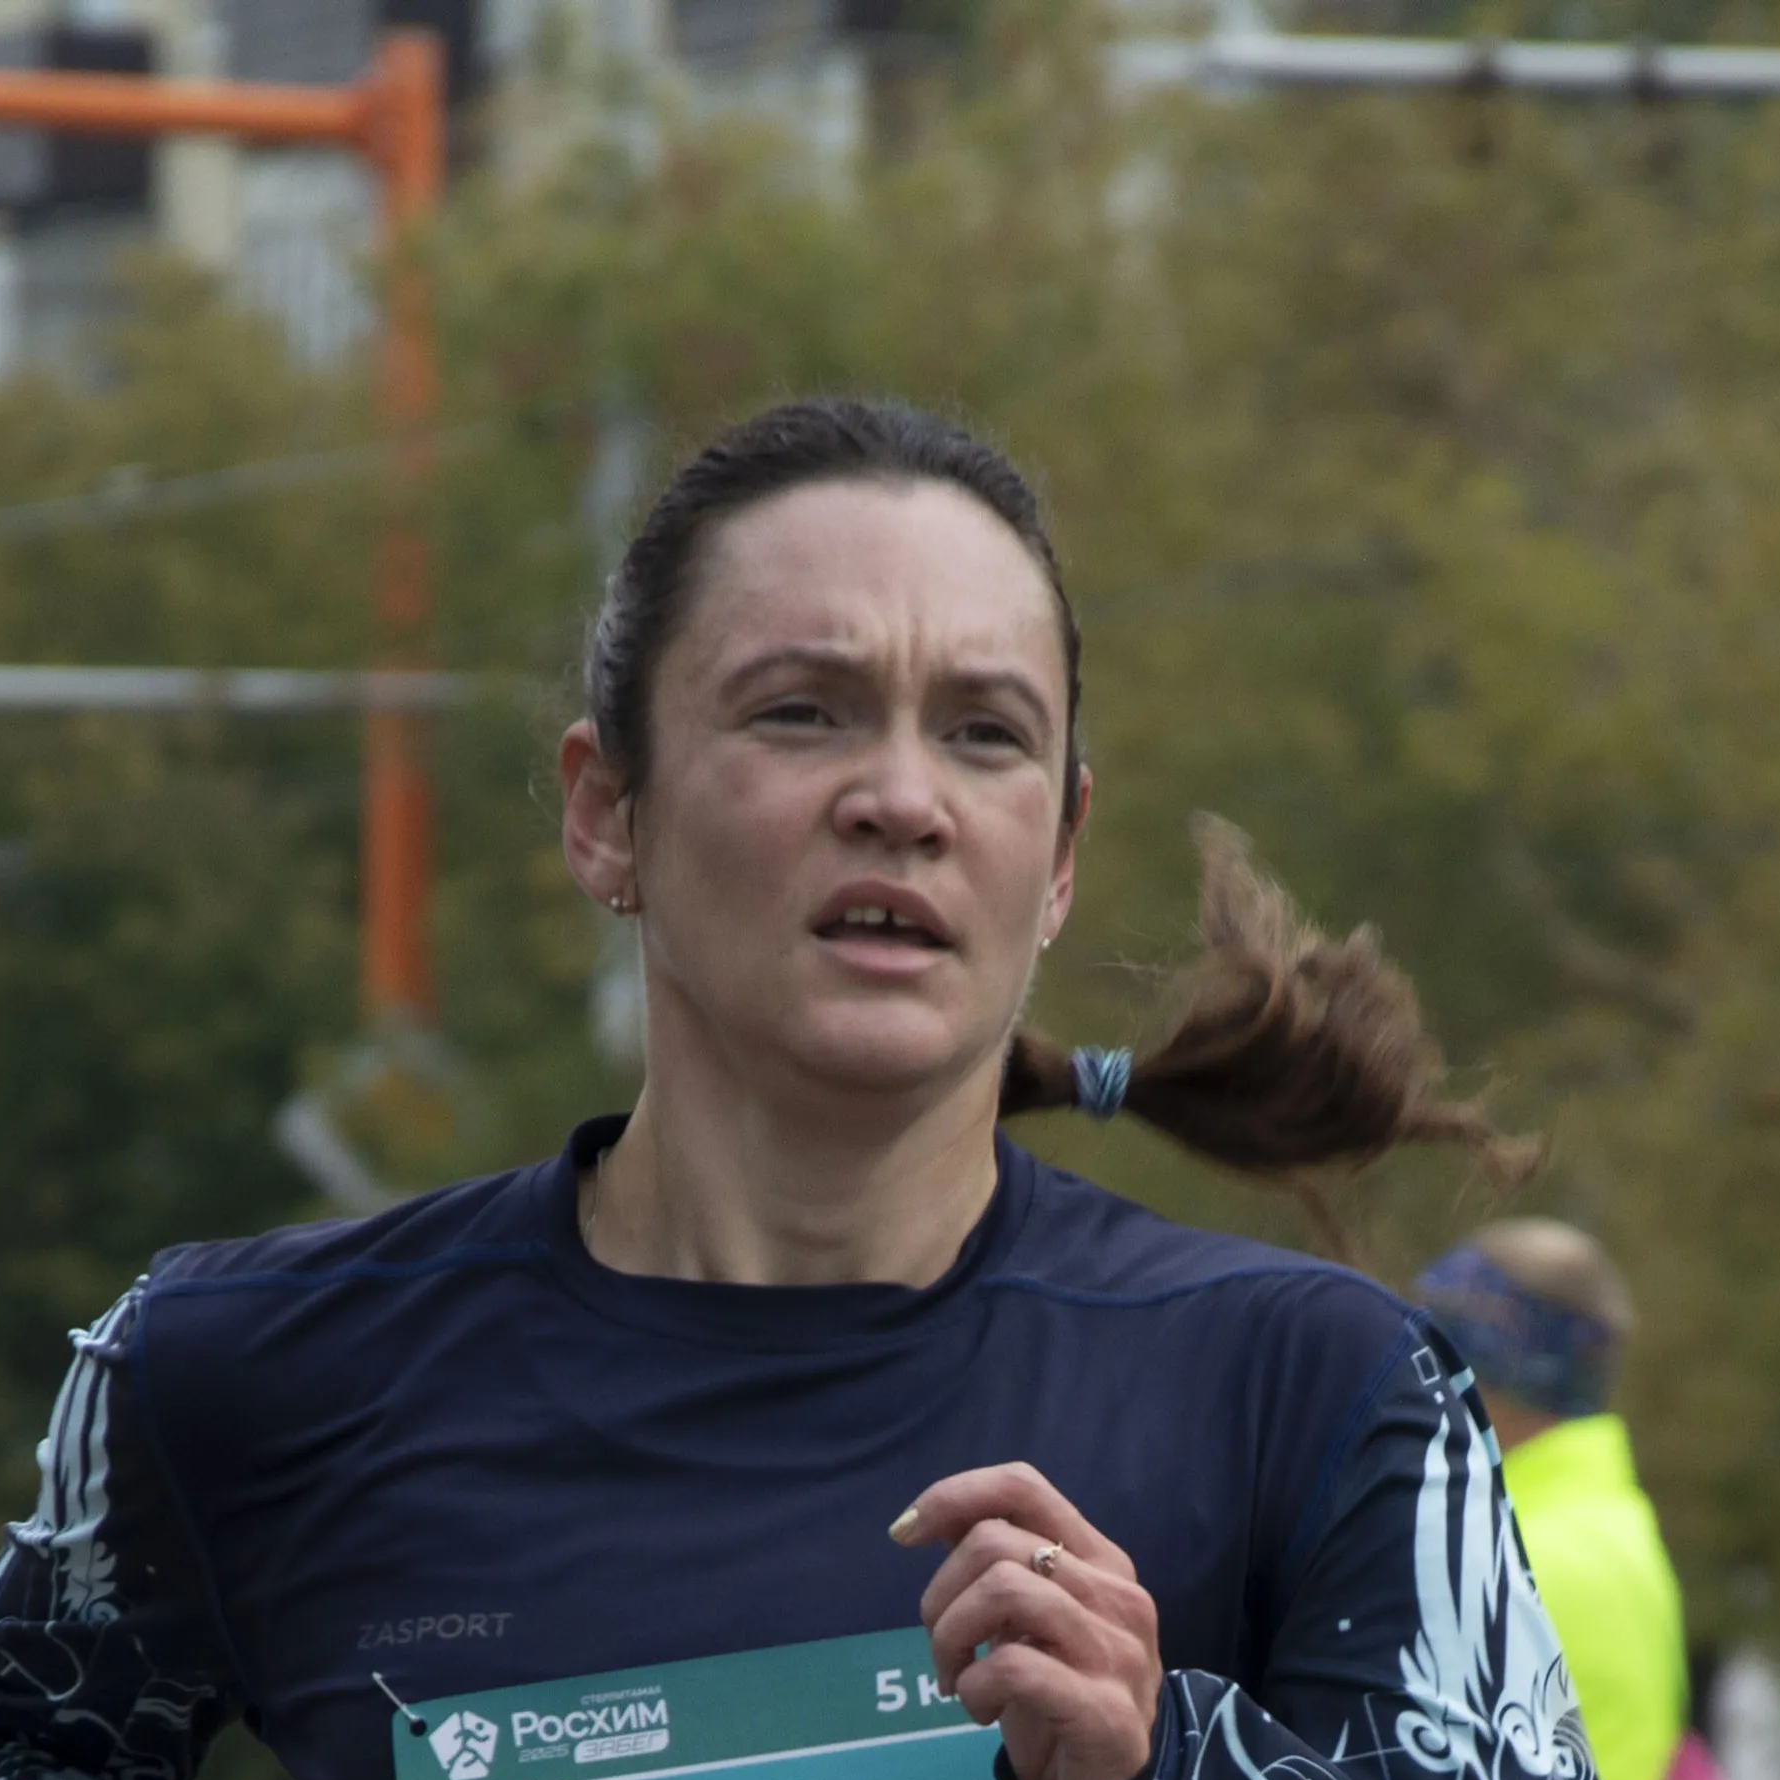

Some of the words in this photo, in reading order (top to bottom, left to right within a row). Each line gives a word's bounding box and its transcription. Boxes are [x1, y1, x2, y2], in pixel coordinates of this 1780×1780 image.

[357, 1612, 514, 1650] ZASPORT
[876, 1669, 907, 1712] 5
[917, 1674, 960, 1706] к
